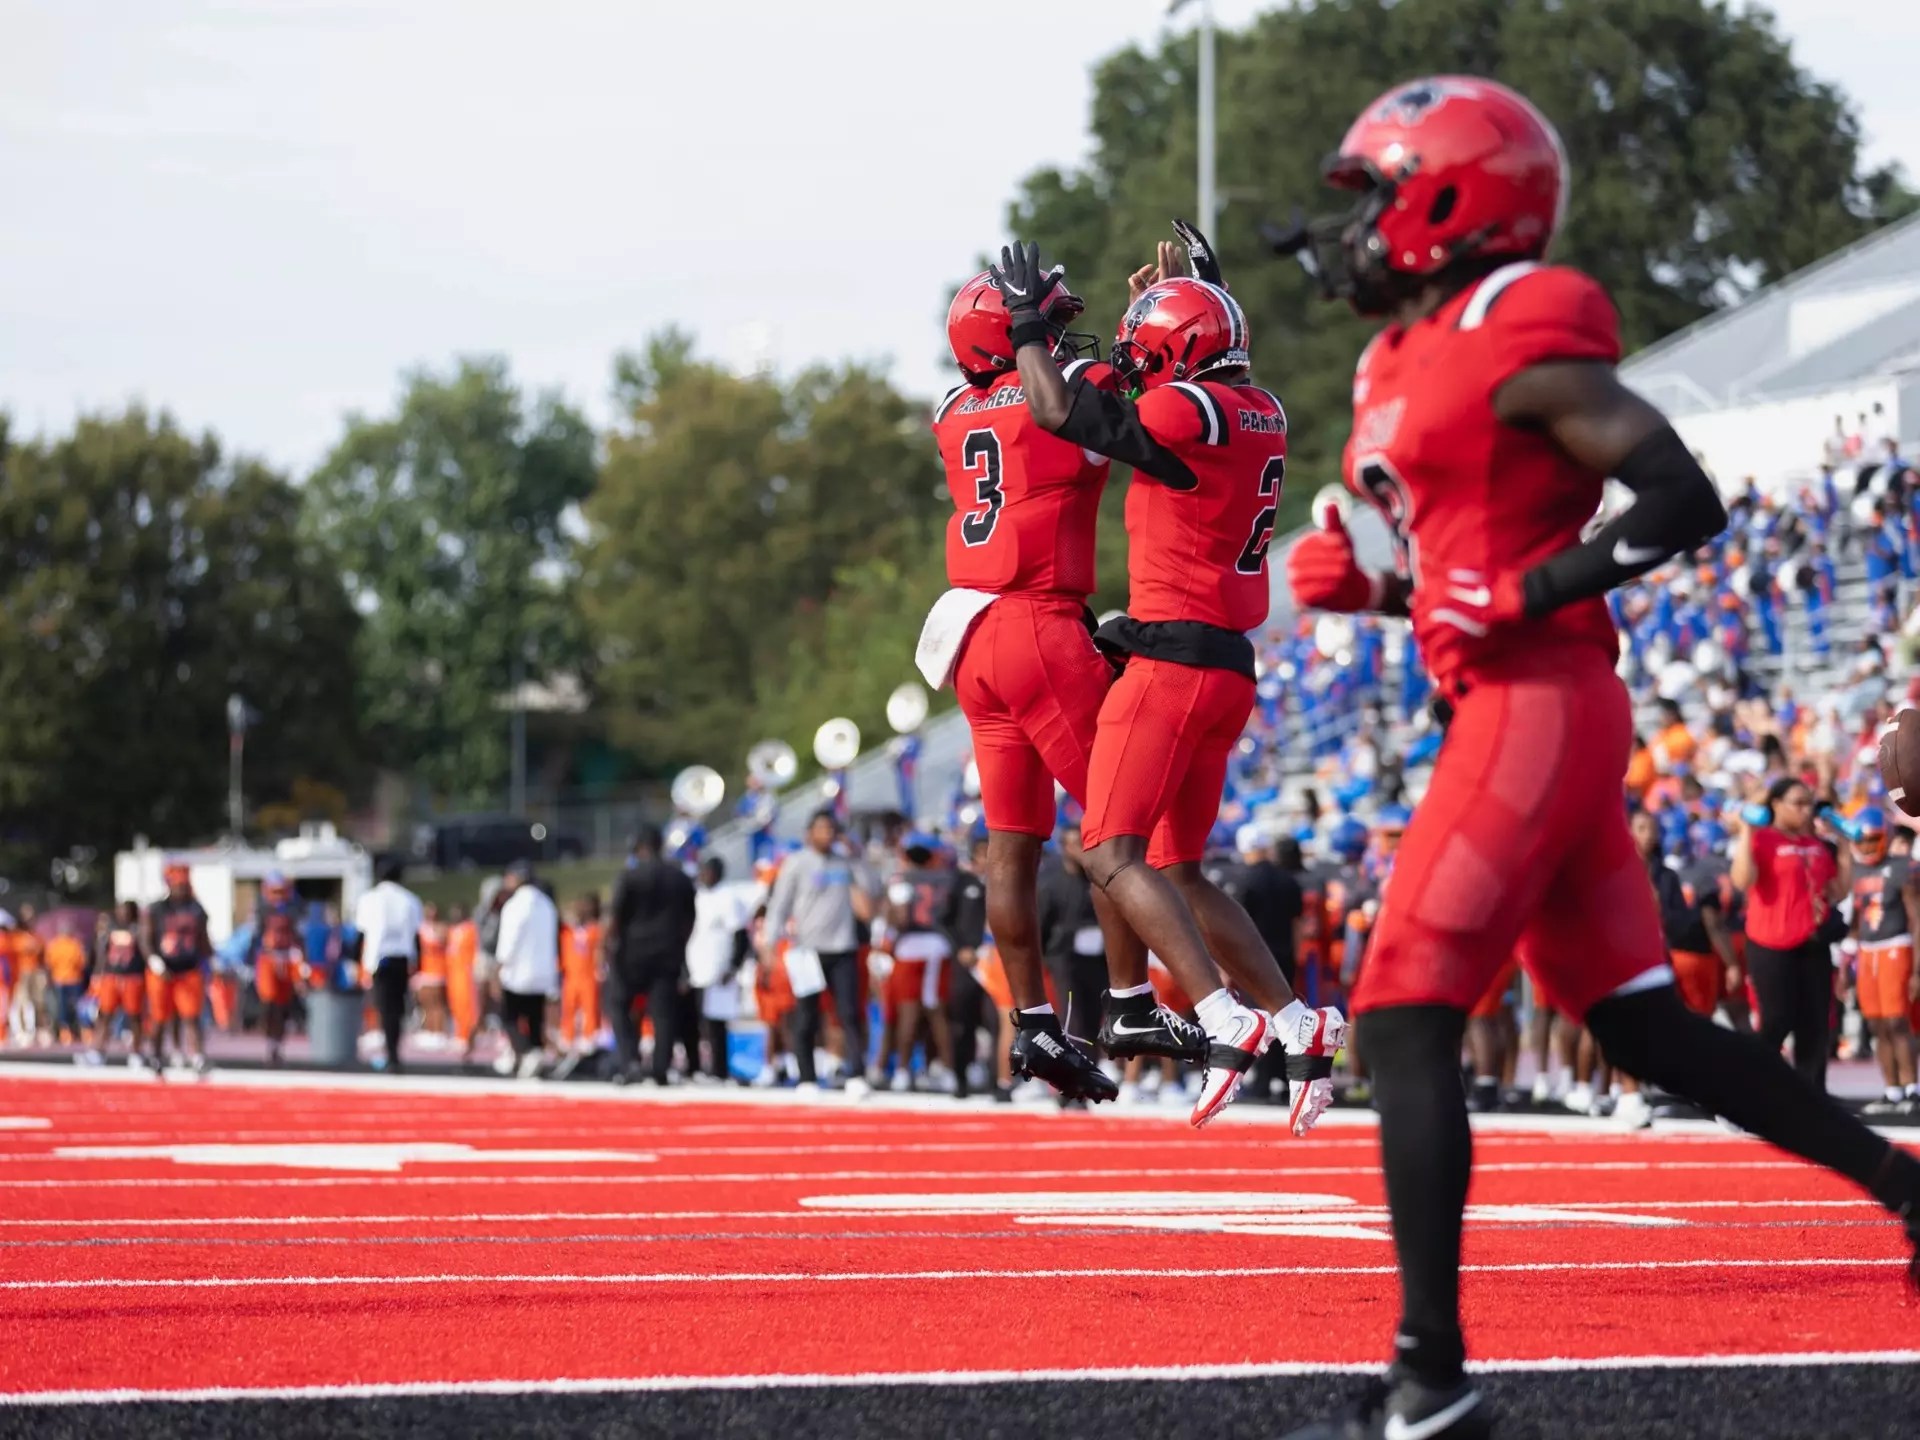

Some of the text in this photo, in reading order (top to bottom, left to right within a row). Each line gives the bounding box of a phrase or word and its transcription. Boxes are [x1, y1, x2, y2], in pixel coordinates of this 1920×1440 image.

[961, 427, 1006, 548] 3
[1235, 455, 1286, 574] 2
[1031, 1031, 1065, 1059] NIKE
[1299, 1015, 1315, 1046] NIKE
